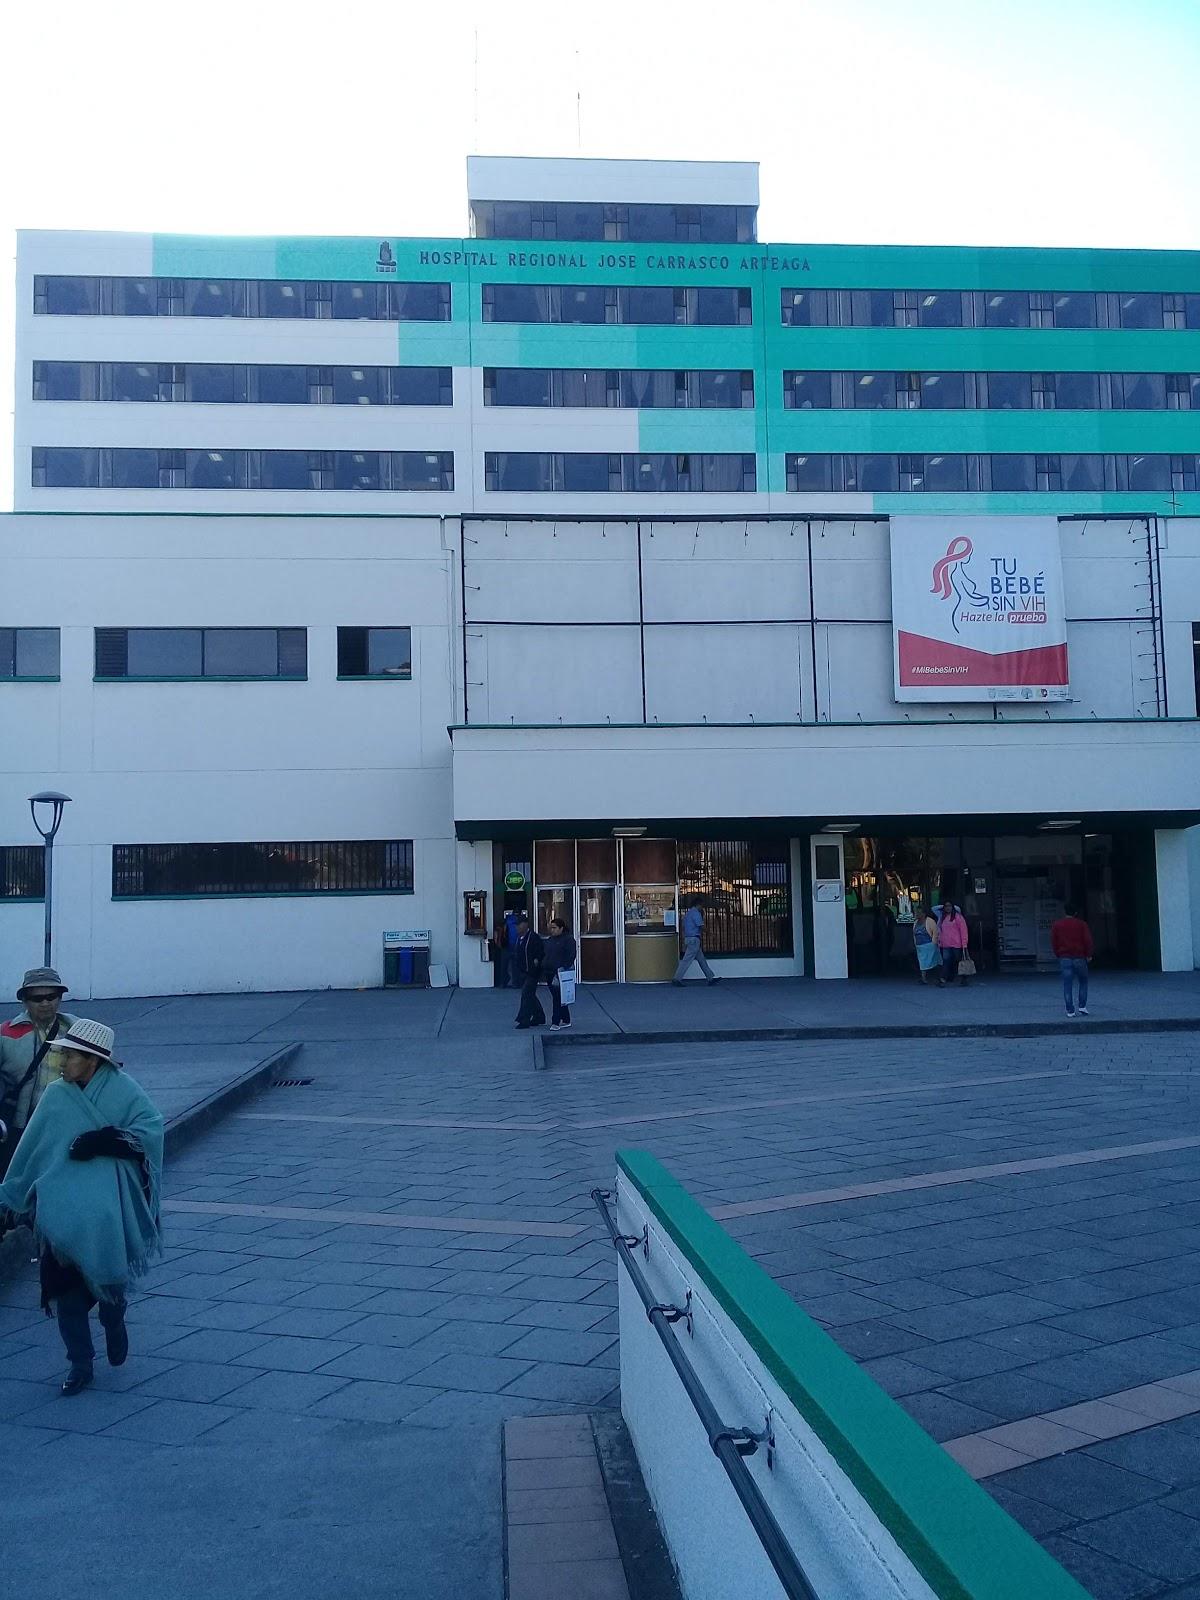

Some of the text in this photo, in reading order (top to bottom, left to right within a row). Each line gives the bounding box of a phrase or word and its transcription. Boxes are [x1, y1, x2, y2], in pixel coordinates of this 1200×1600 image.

[420, 251, 810, 271] HOSPITAL REGIONAL JOSE CARRASCO ARTEAGA
[991, 558, 1017, 575] TU
[991, 571, 1045, 594] BEBÉ
[992, 596, 1046, 611] SIN VIH
[960, 611, 1045, 623] Hazte la prueba
[506, 876, 523, 884] JEP
